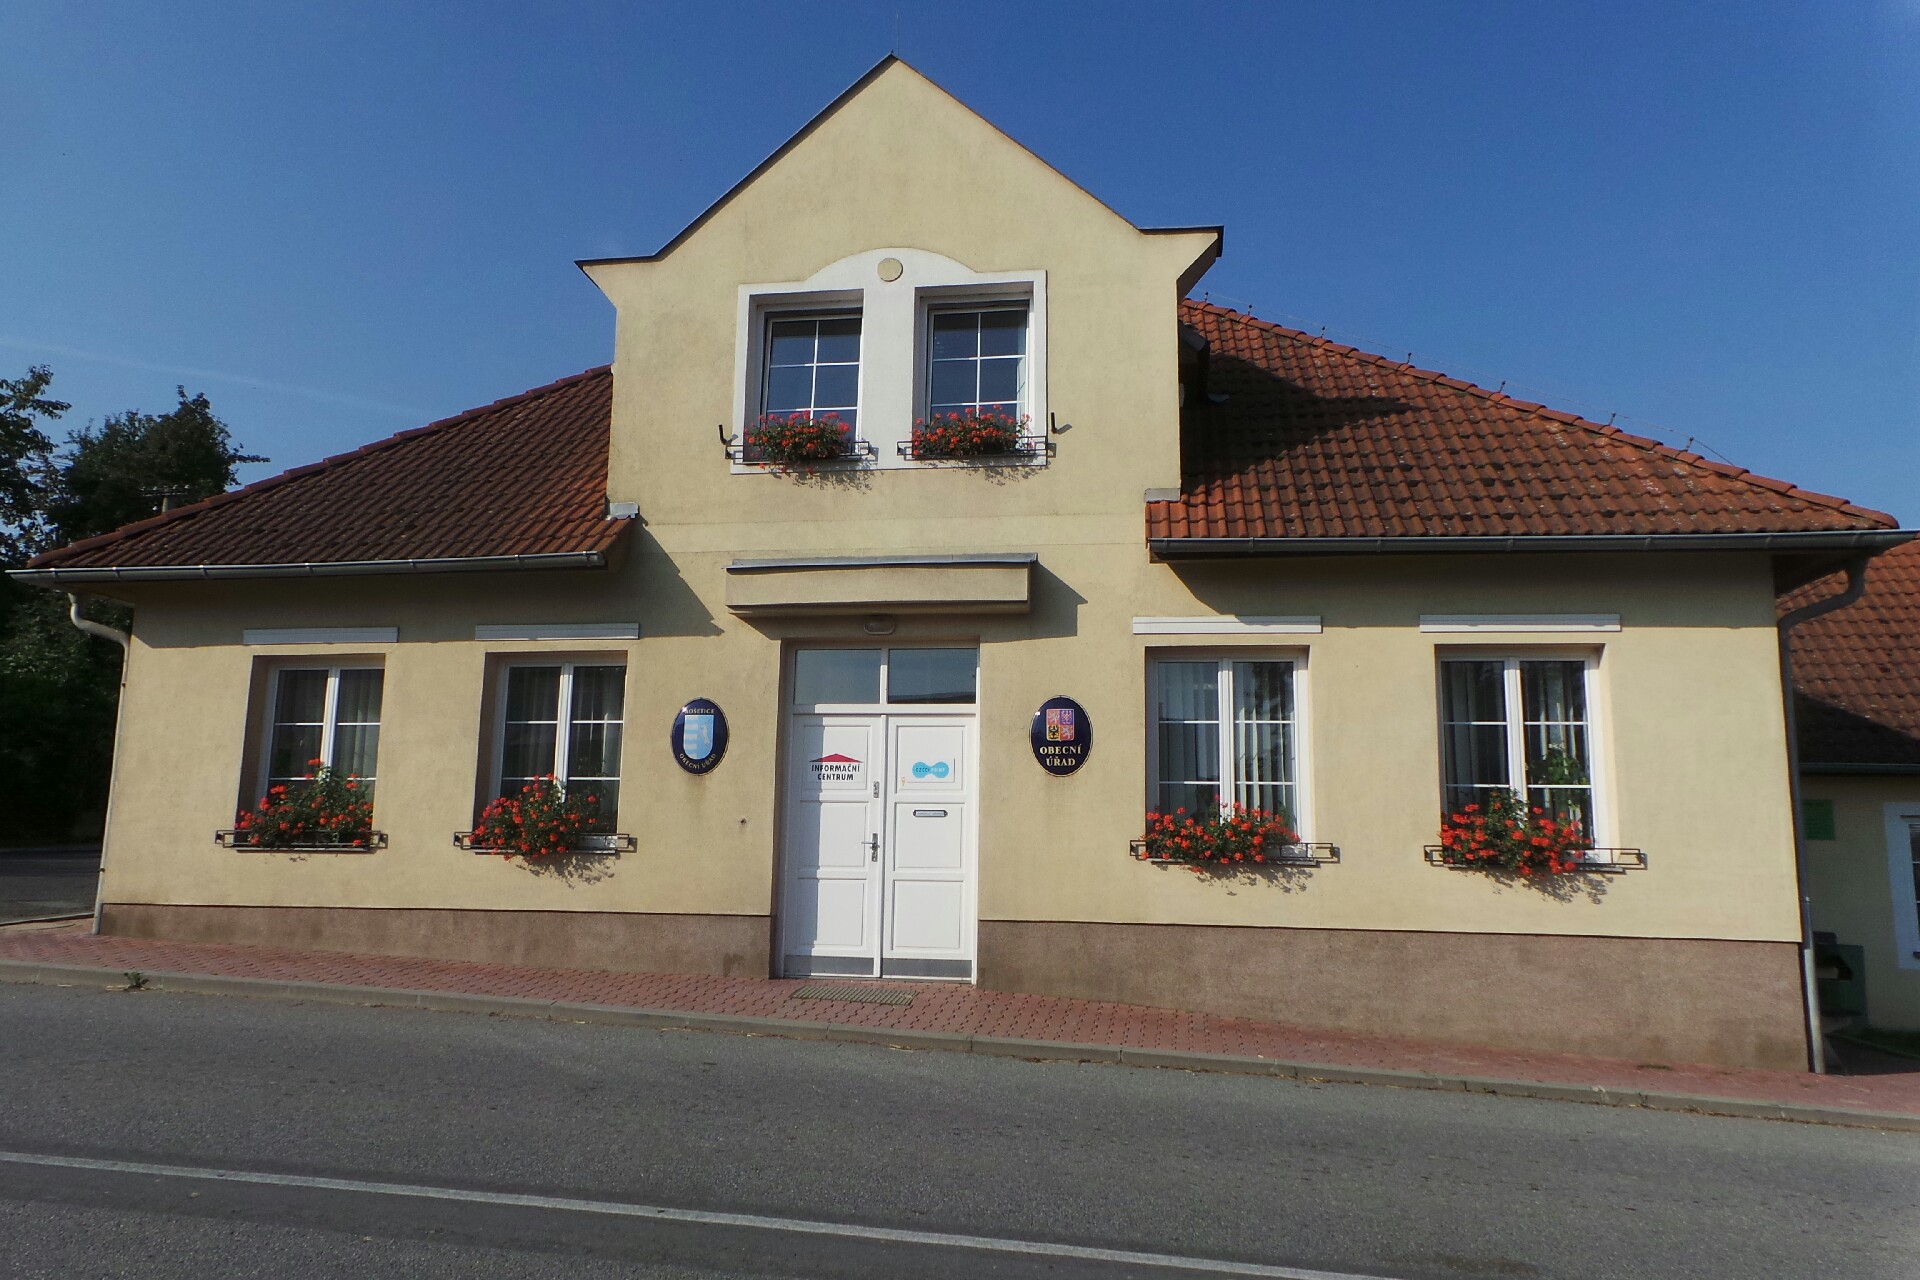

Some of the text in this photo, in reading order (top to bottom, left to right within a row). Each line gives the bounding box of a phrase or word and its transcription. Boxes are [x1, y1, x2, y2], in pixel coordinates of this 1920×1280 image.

[1040, 744, 1082, 754] OBECNÍ
[1046, 756, 1076, 766] ÚŘAD
[811, 764, 860, 772] INFORMAČNÍ
[817, 773, 854, 781] CENTRUM
